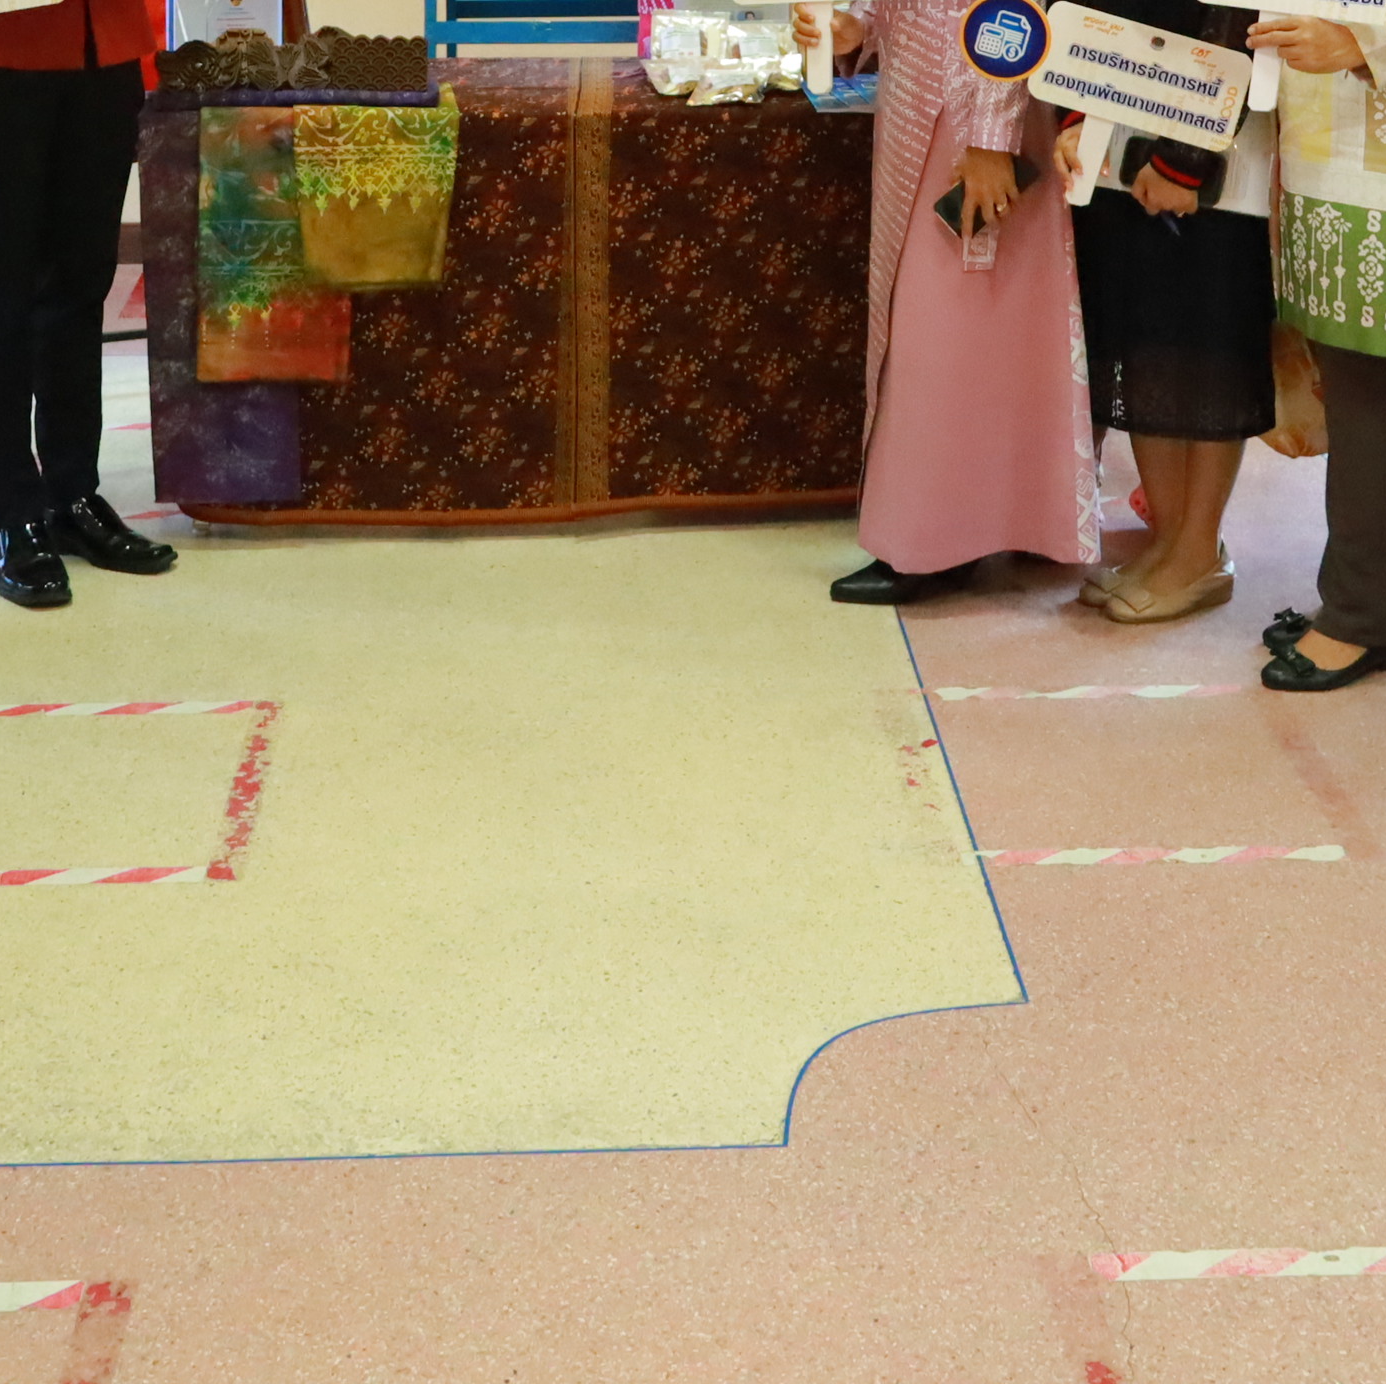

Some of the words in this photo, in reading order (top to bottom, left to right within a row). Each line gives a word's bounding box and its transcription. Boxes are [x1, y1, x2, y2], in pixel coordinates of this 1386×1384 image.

[1069, 43, 1224, 97] การบริหารจัดการหนี้
[1190, 46, 1212, 58] CBT
[1043, 70, 1229, 134] กองทุนพัฒนาบทบาทสตรี
